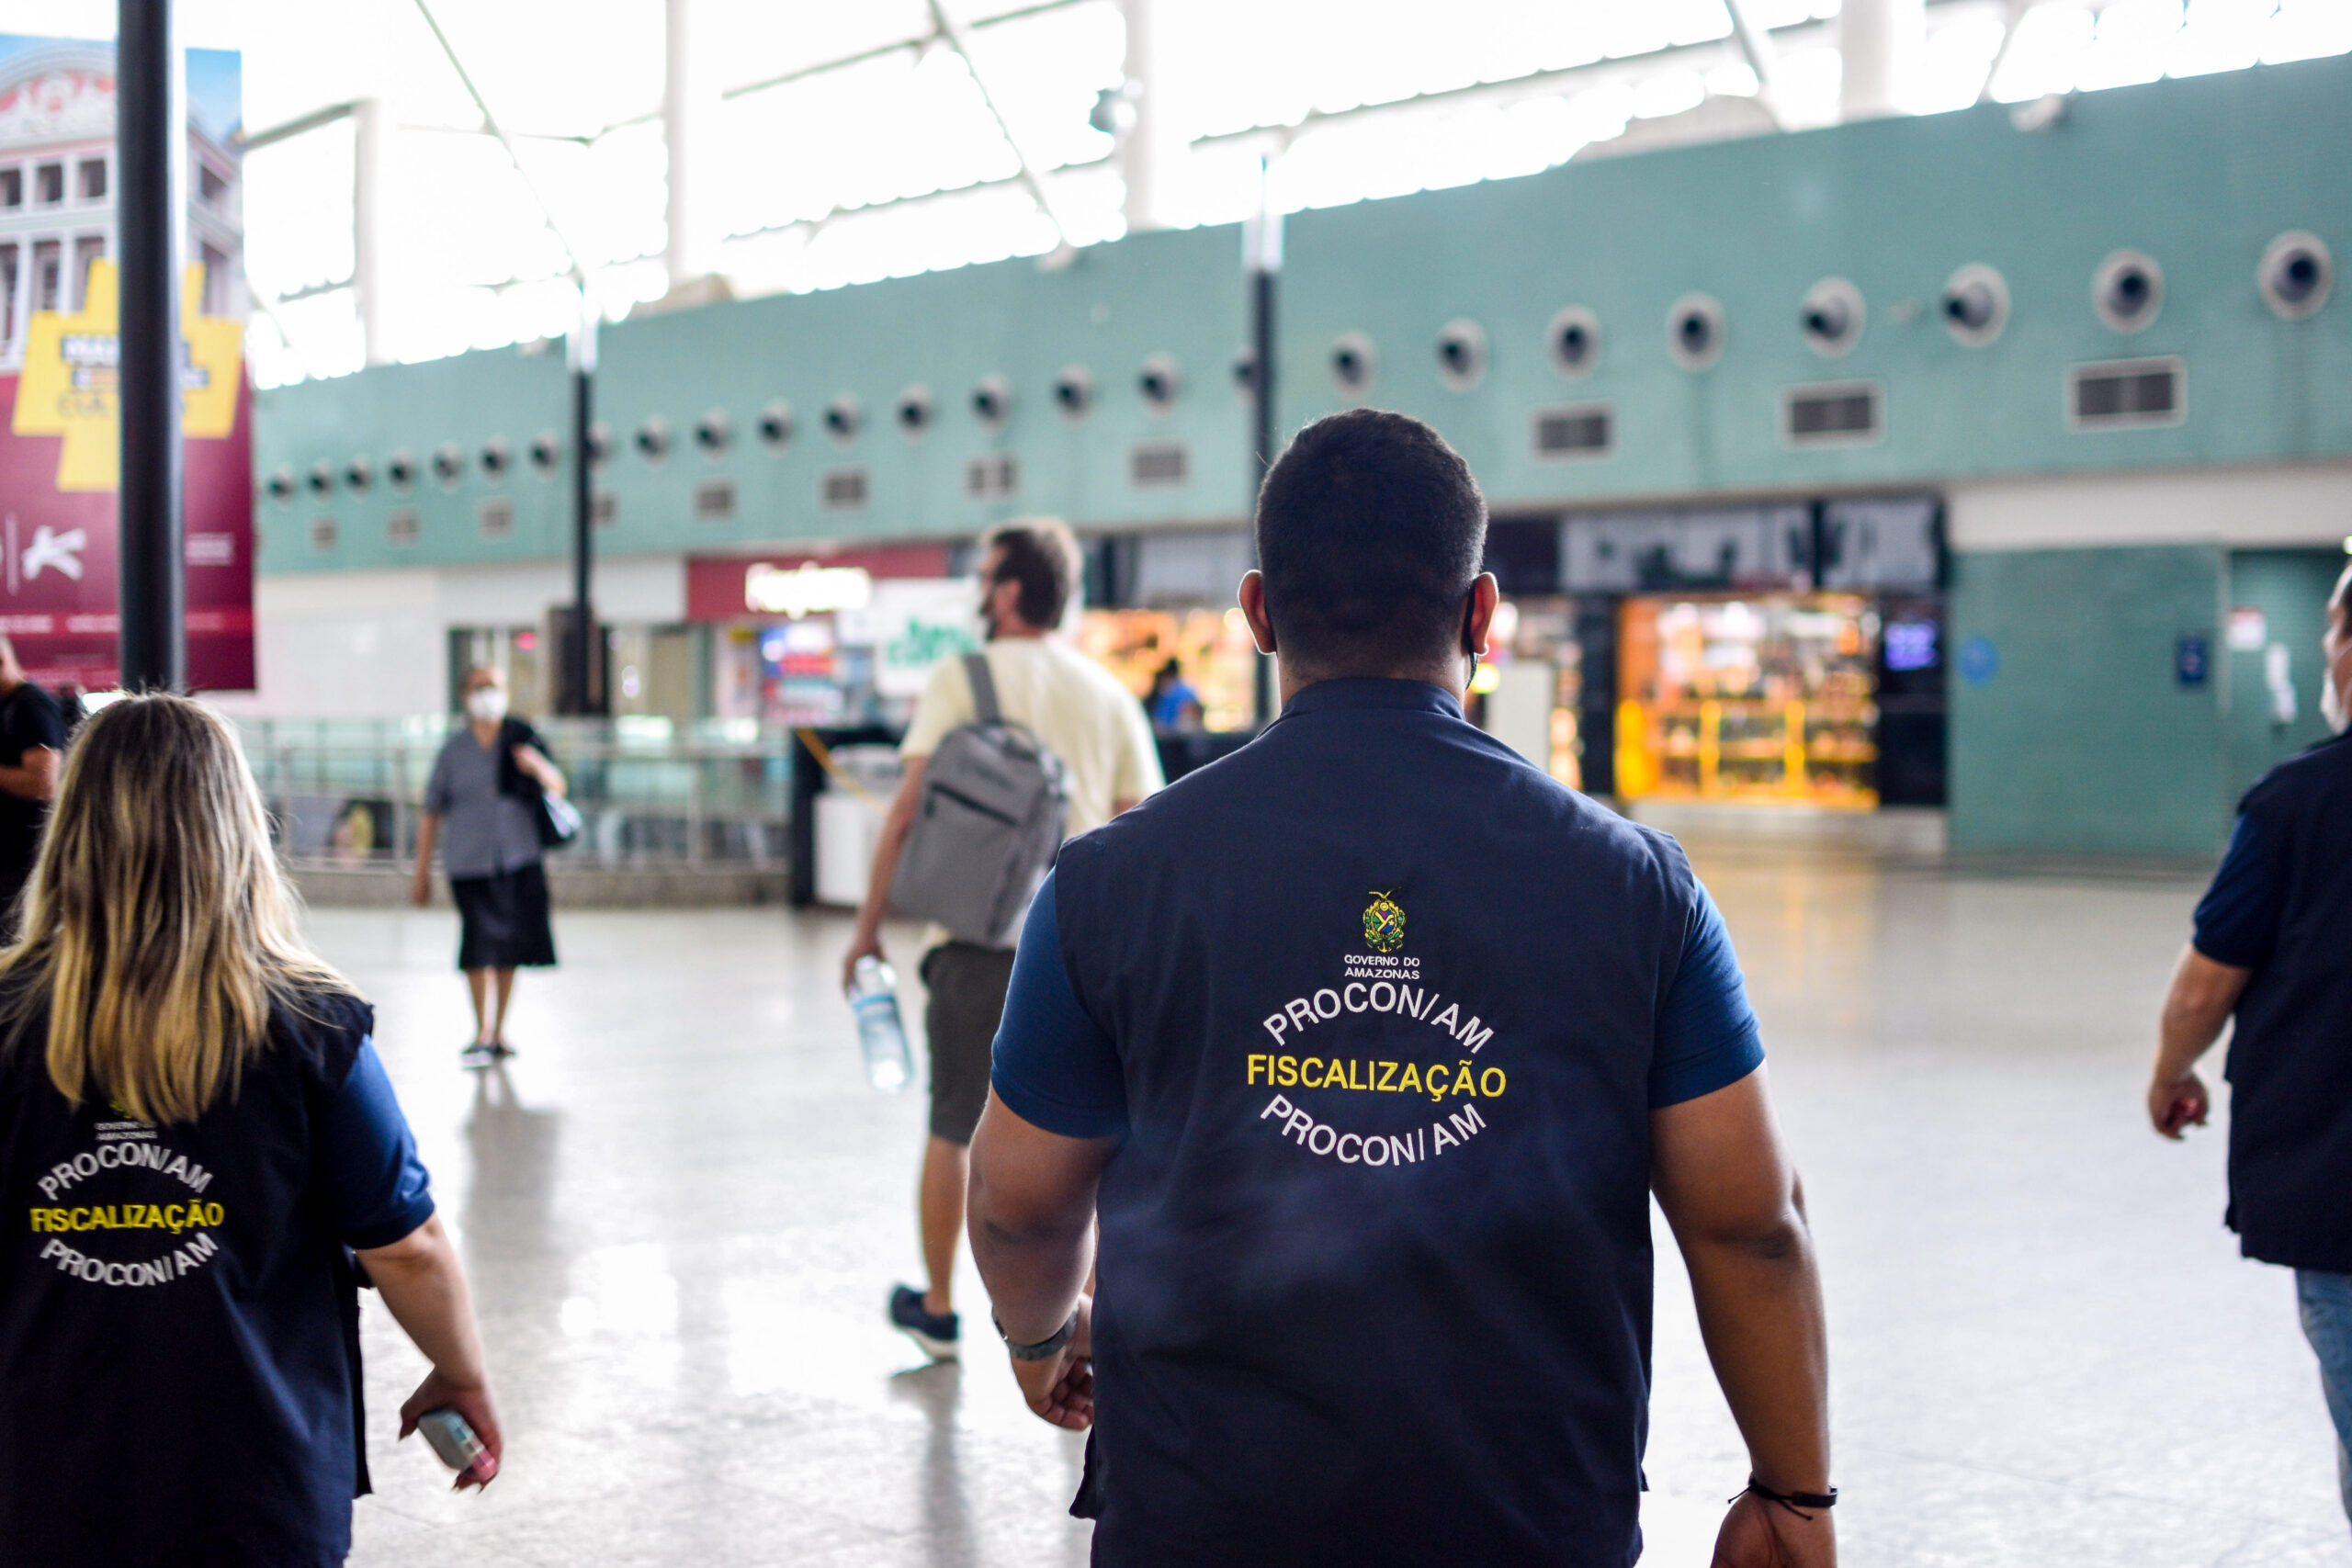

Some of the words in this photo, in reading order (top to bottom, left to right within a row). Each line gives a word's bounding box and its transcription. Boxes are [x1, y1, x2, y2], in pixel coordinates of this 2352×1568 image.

[1343, 953, 1399, 966] GOVERNO
[1403, 956, 1420, 967] DO
[1344, 967, 1420, 980] AMAZONAS
[1262, 981, 1495, 1055] PROCON/AM
[1247, 1054, 1507, 1102] FISCALIZAÇÃO
[29, 1198, 225, 1235] FISCALIZAÇÃO
